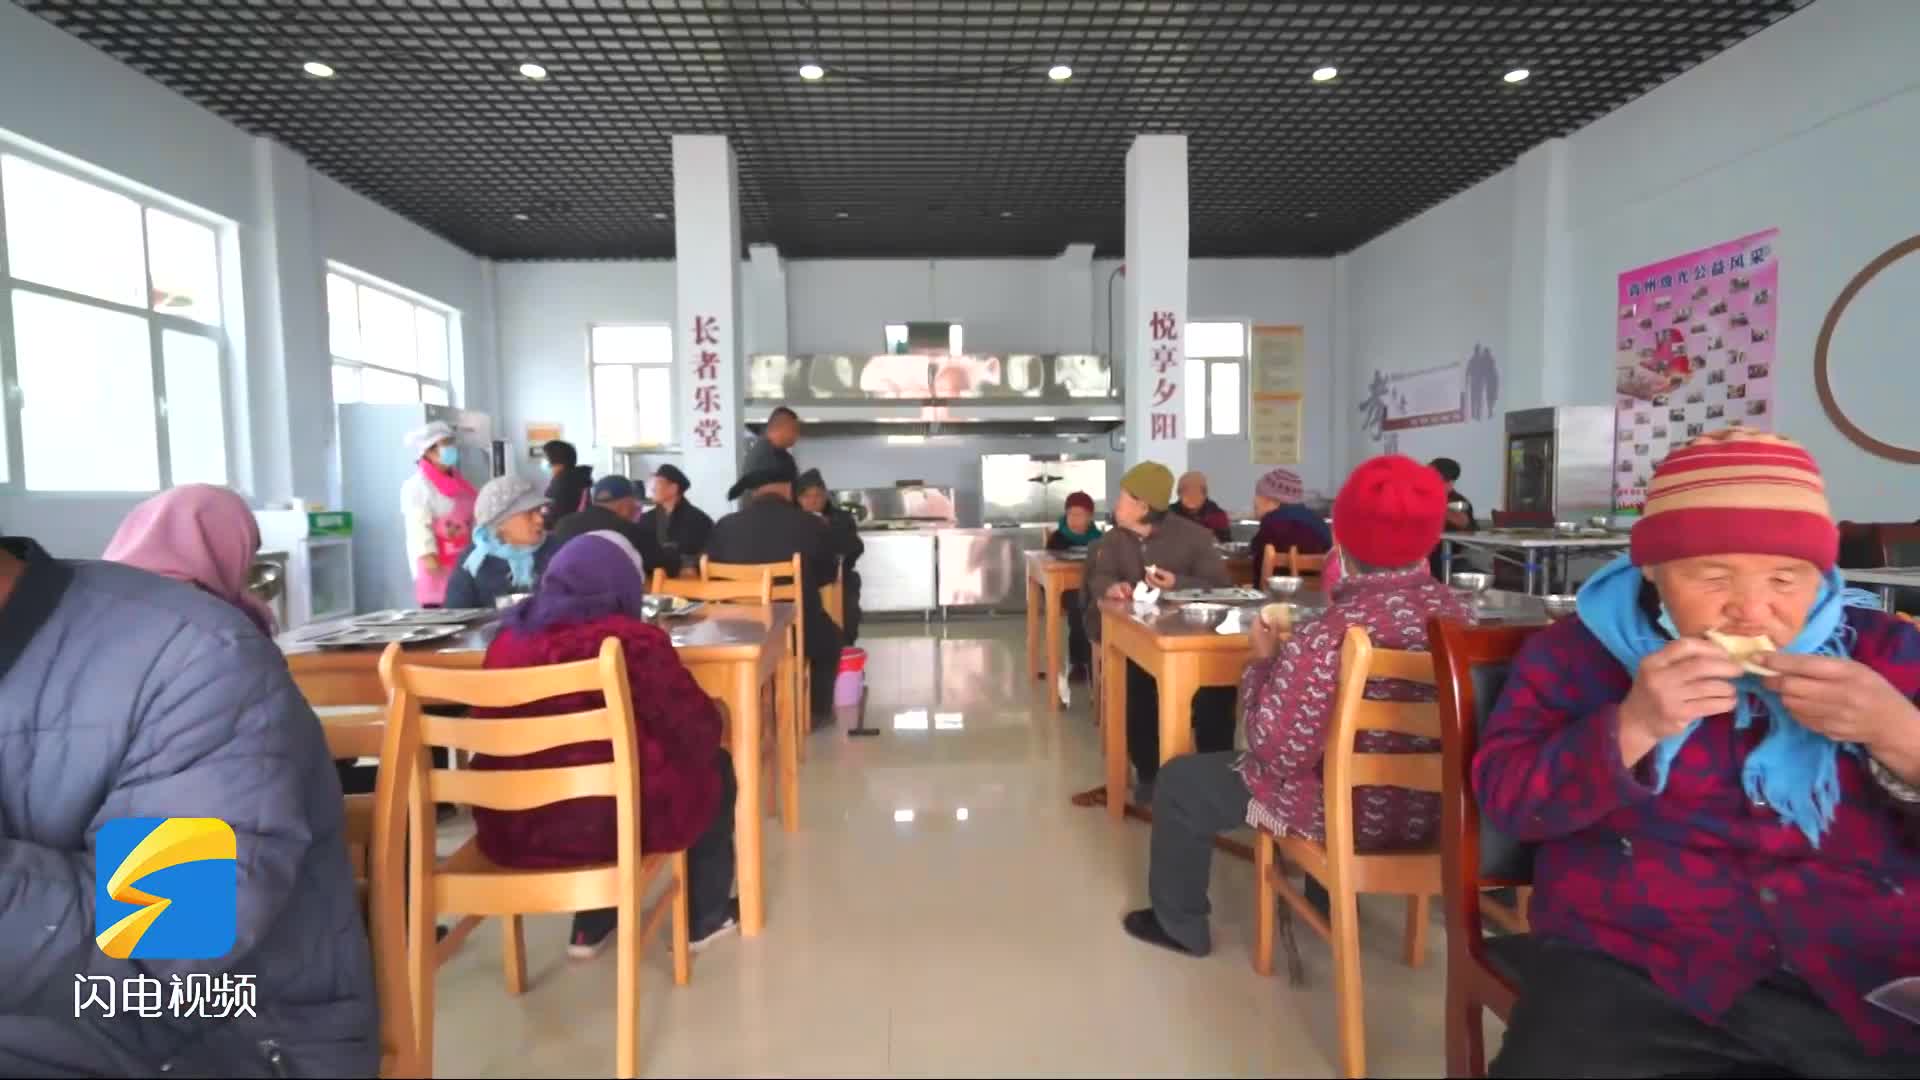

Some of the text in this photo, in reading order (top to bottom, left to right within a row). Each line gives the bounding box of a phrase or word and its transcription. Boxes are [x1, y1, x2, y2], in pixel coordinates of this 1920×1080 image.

[691, 315, 722, 448] 长者乐堂
[1149, 311, 1178, 441] 悦享夕阳
